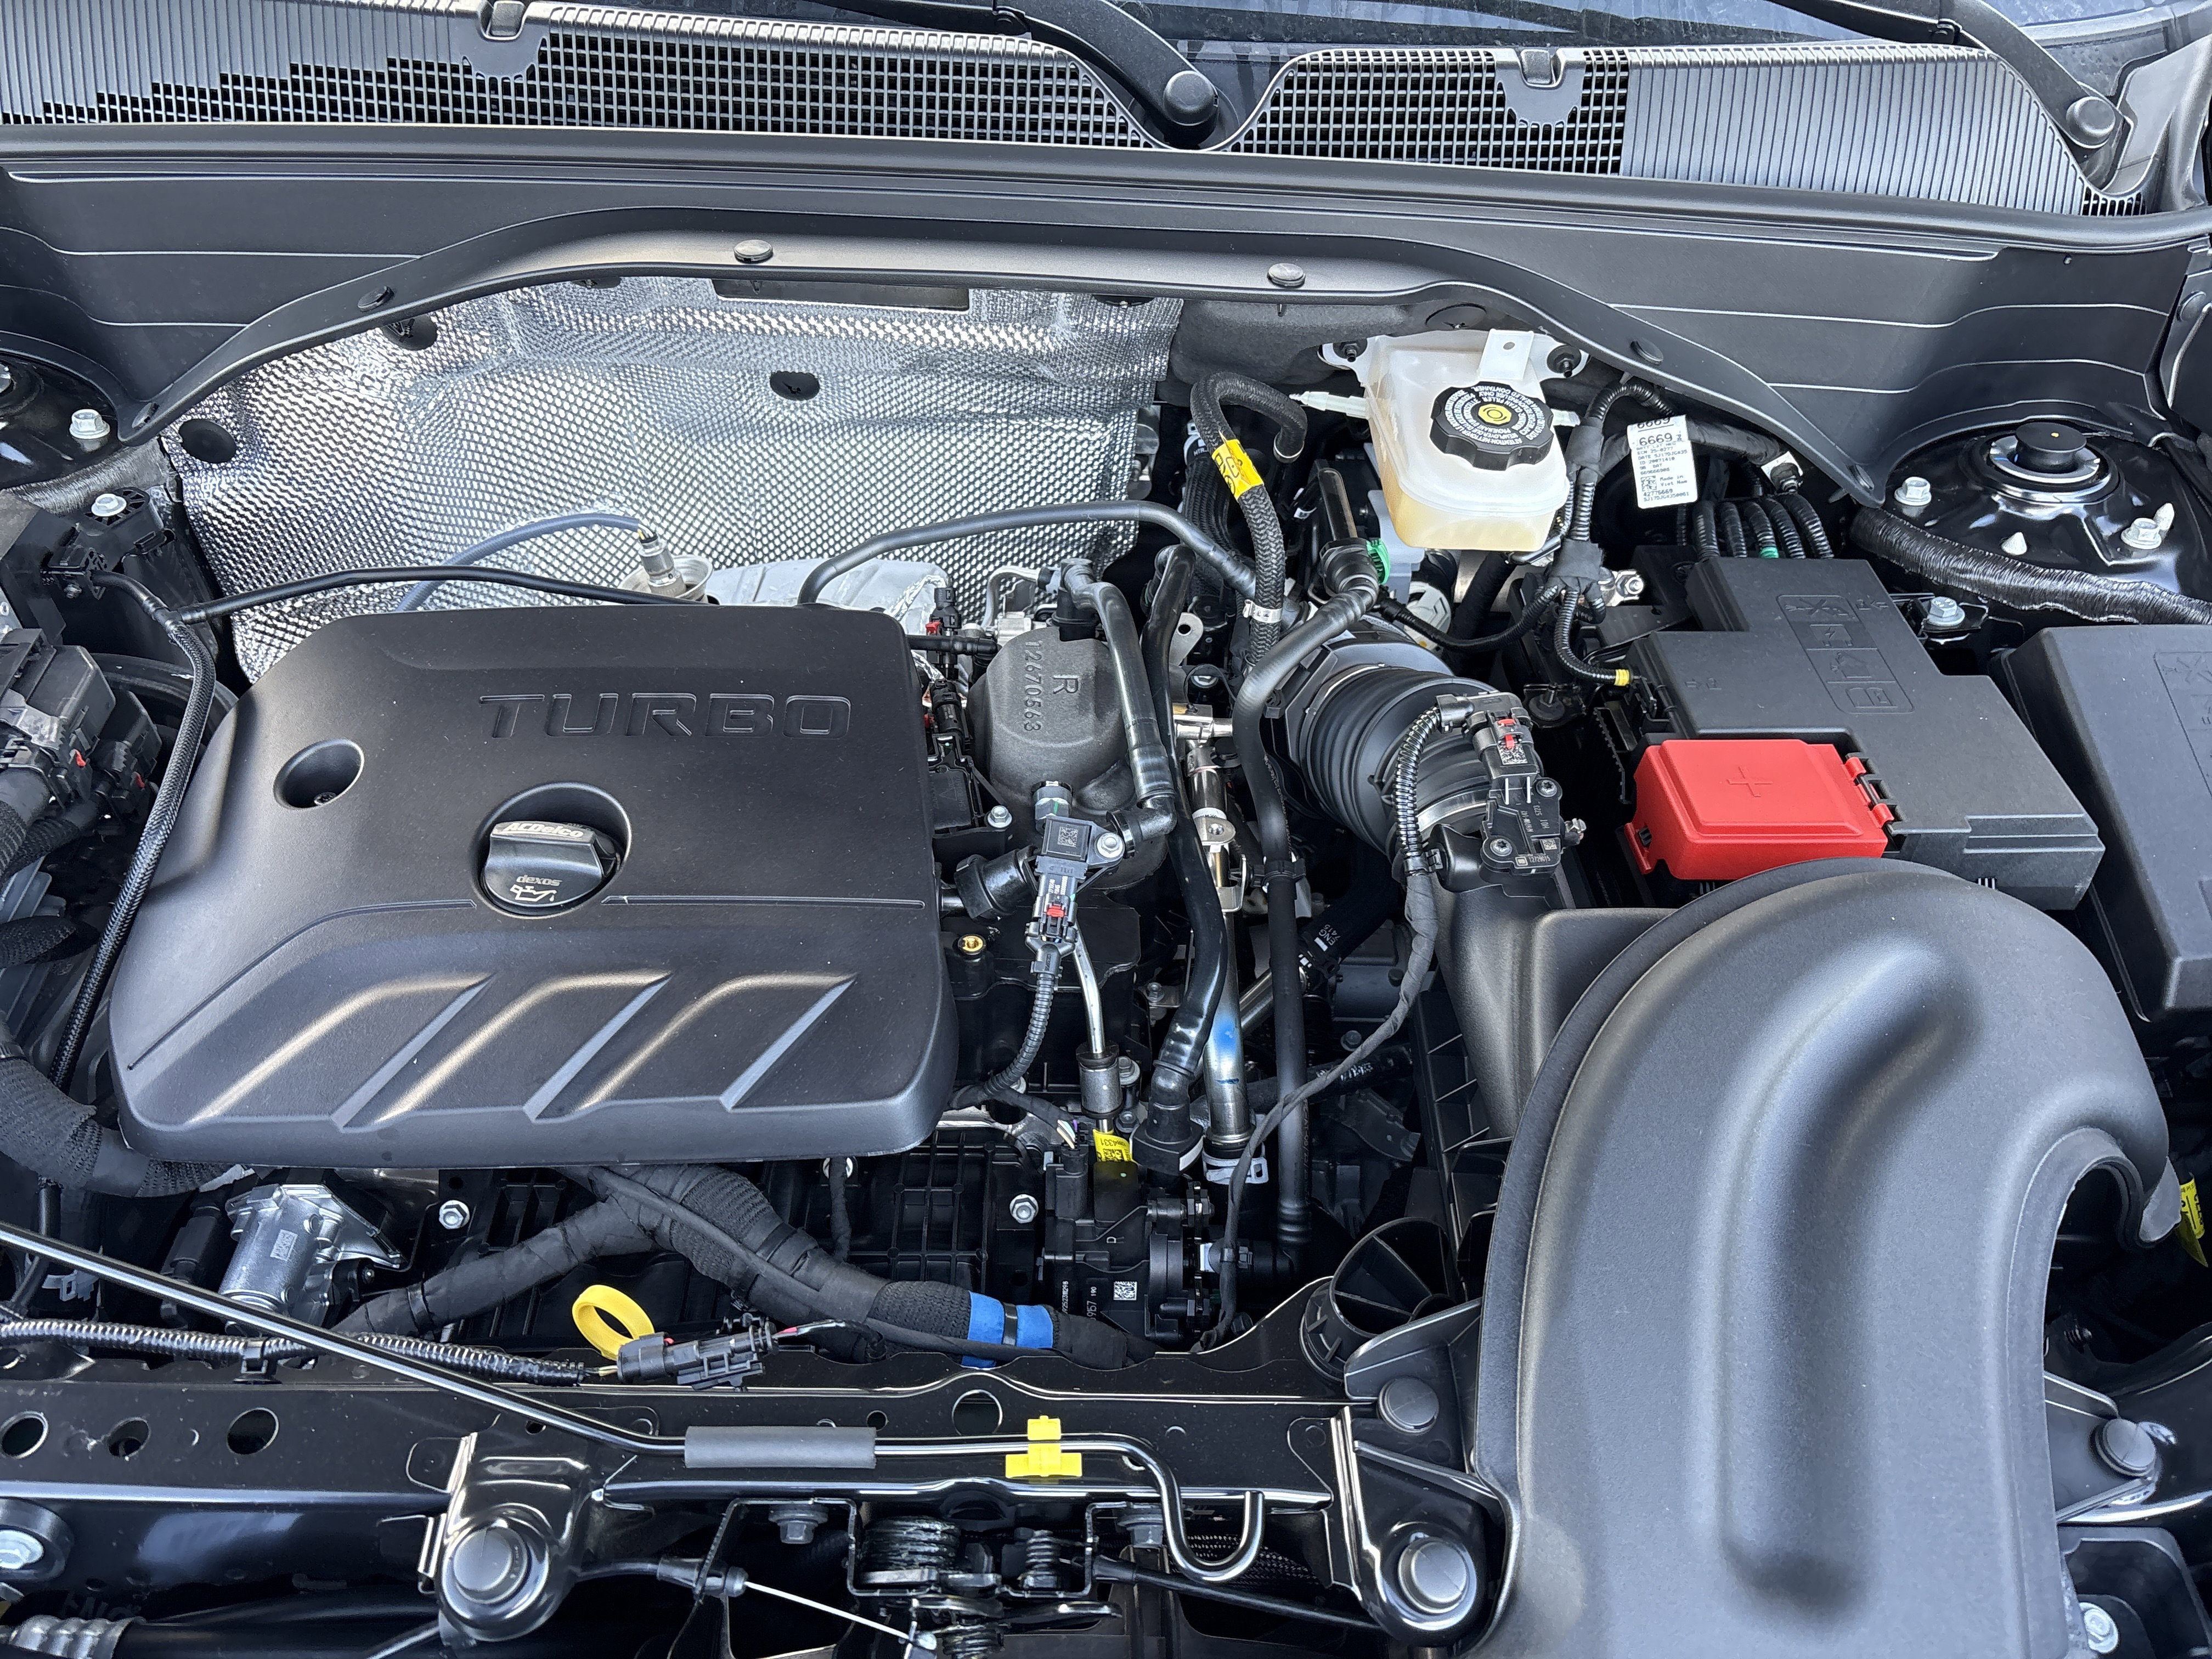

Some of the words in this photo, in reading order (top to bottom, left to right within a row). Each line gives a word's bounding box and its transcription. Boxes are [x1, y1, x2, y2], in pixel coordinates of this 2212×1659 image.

[1639, 433, 1673, 446] 6669
[1024, 639, 1043, 732] 12670563
[1052, 673, 1079, 695] R
[479, 692, 852, 739] TURBO
[503, 822, 584, 839] ACDelco
[516, 874, 563, 887] dexos
[1318, 929, 1336, 946] ENG
[1323, 923, 1343, 941] 7415
[1086, 1300, 1097, 1322] 9157
